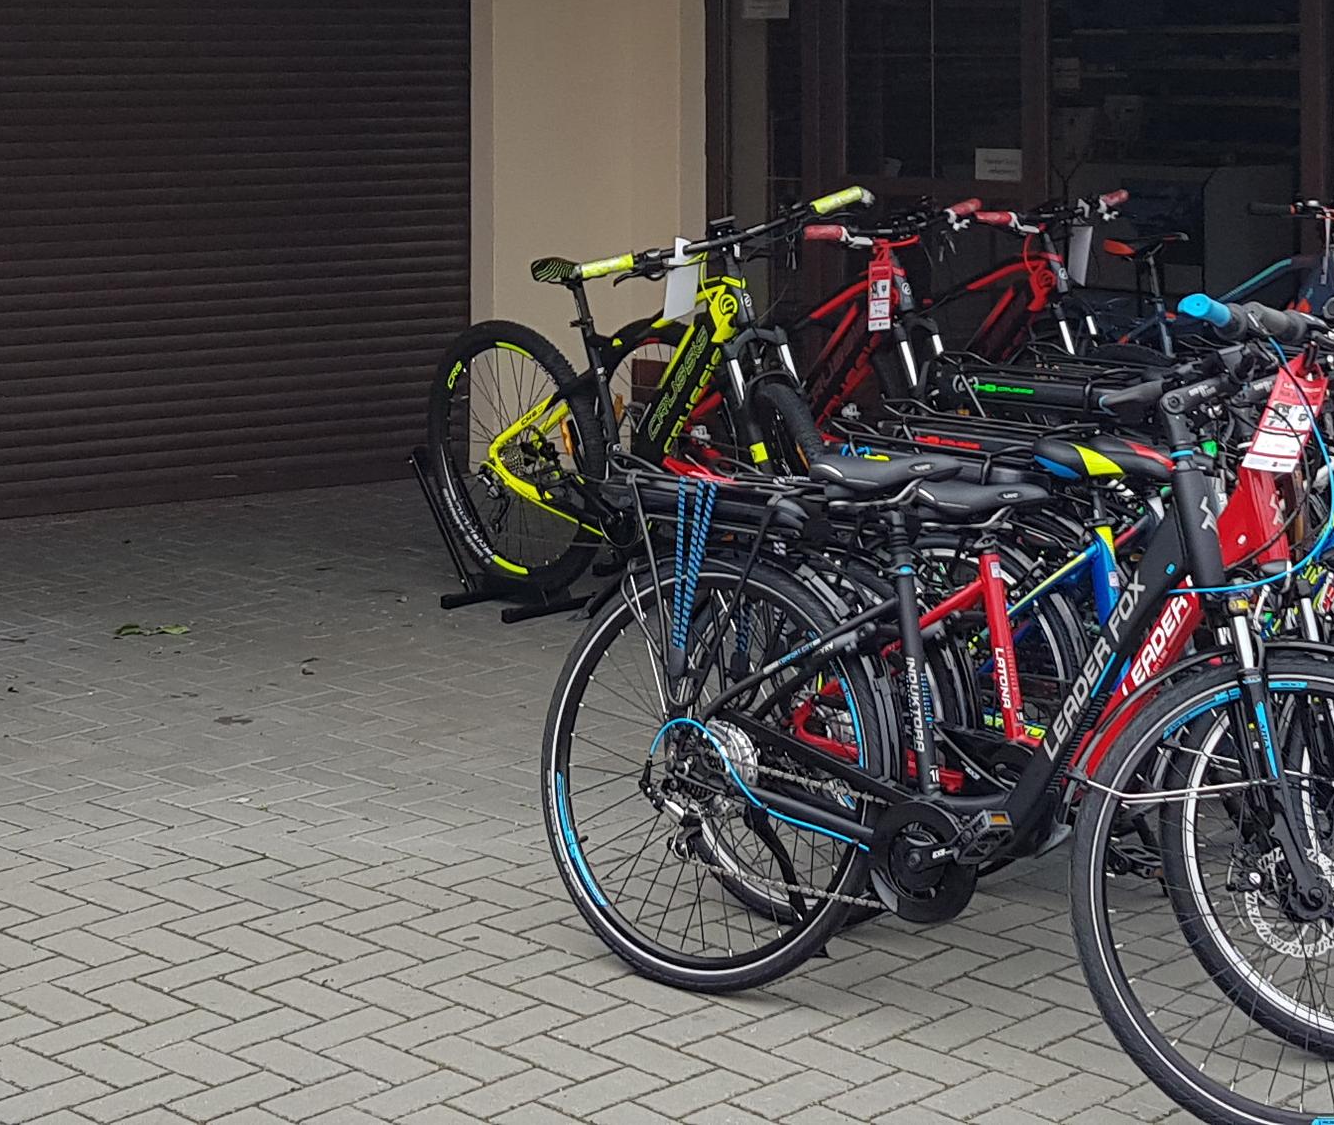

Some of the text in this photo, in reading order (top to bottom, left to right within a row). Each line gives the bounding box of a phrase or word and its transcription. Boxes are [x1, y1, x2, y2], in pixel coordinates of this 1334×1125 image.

[905, 656, 925, 753] INDUKTORA
[994, 647, 1012, 709] LATONA
[1043, 570, 1146, 762] LEADER FOX
